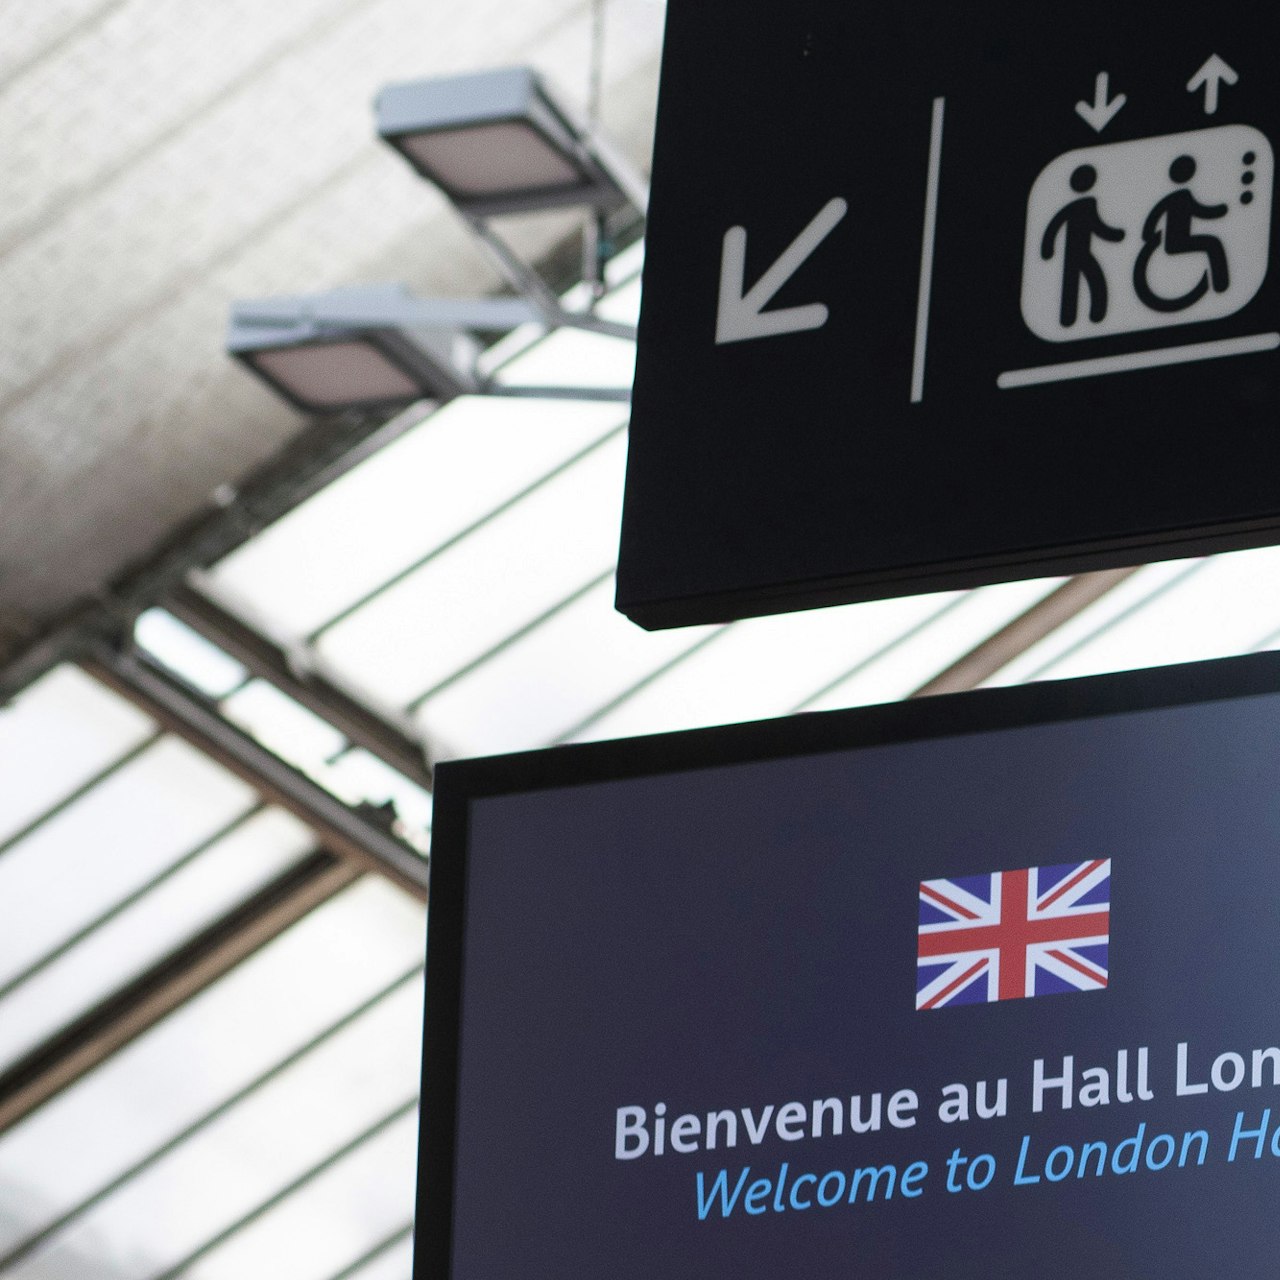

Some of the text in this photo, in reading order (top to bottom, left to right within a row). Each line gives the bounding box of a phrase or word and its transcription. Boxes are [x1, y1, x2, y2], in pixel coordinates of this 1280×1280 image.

[615, 1088, 919, 1160] Bienvenue
[938, 1078, 1008, 1123] au
[1032, 1046, 1155, 1113] Hall
[696, 1161, 929, 1220] Welcome
[946, 1148, 996, 1193] to
[1013, 1122, 1209, 1185] London
